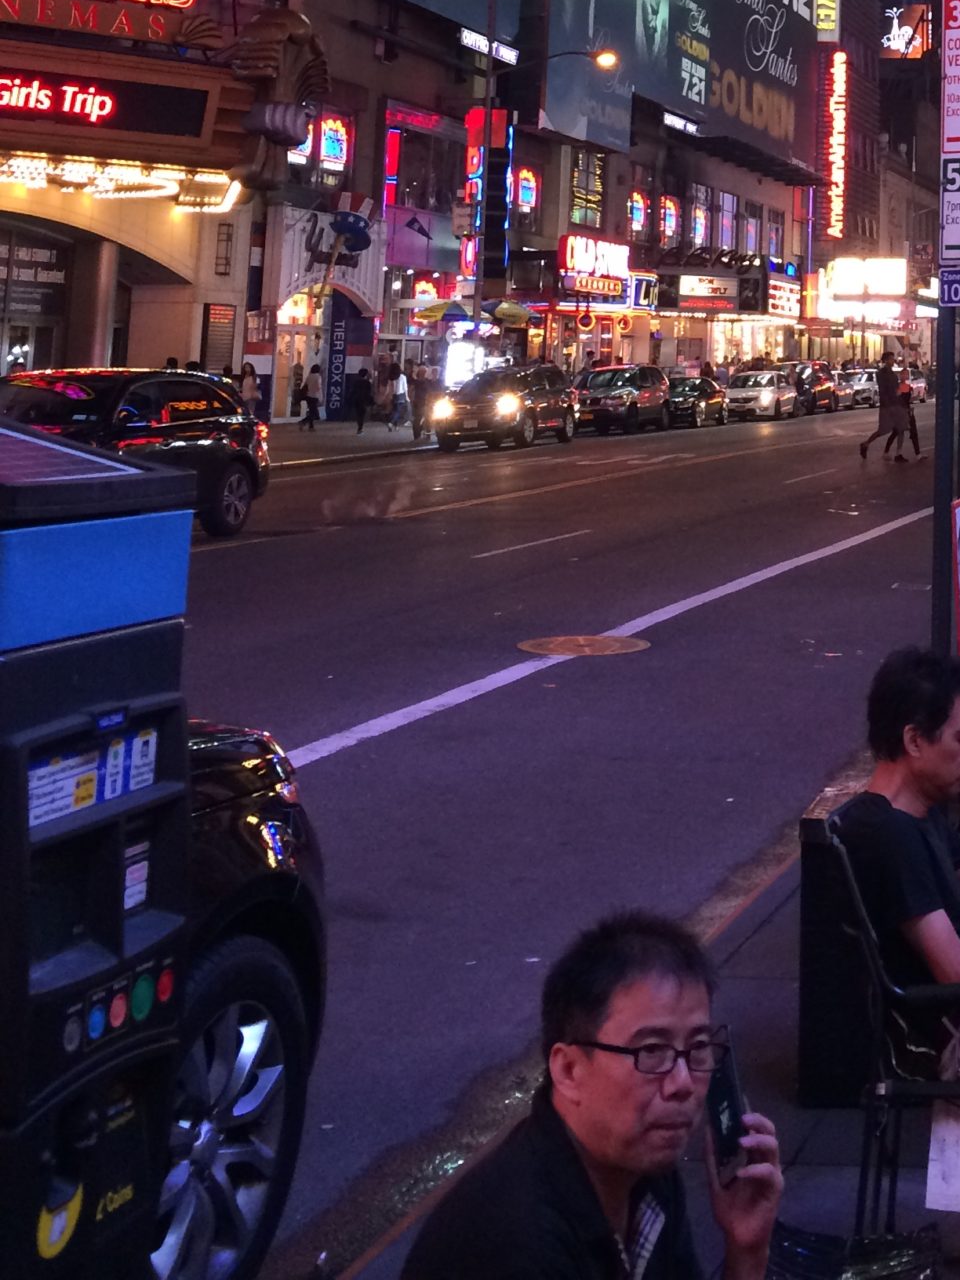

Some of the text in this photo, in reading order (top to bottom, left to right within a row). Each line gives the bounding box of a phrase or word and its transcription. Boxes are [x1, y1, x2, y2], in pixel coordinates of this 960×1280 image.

[744, 4, 798, 87] Santos
[0, 78, 112, 123] Girls Trip
[681, 70, 706, 105] 7.21
[329, 320, 345, 408] TIER BOX 245
